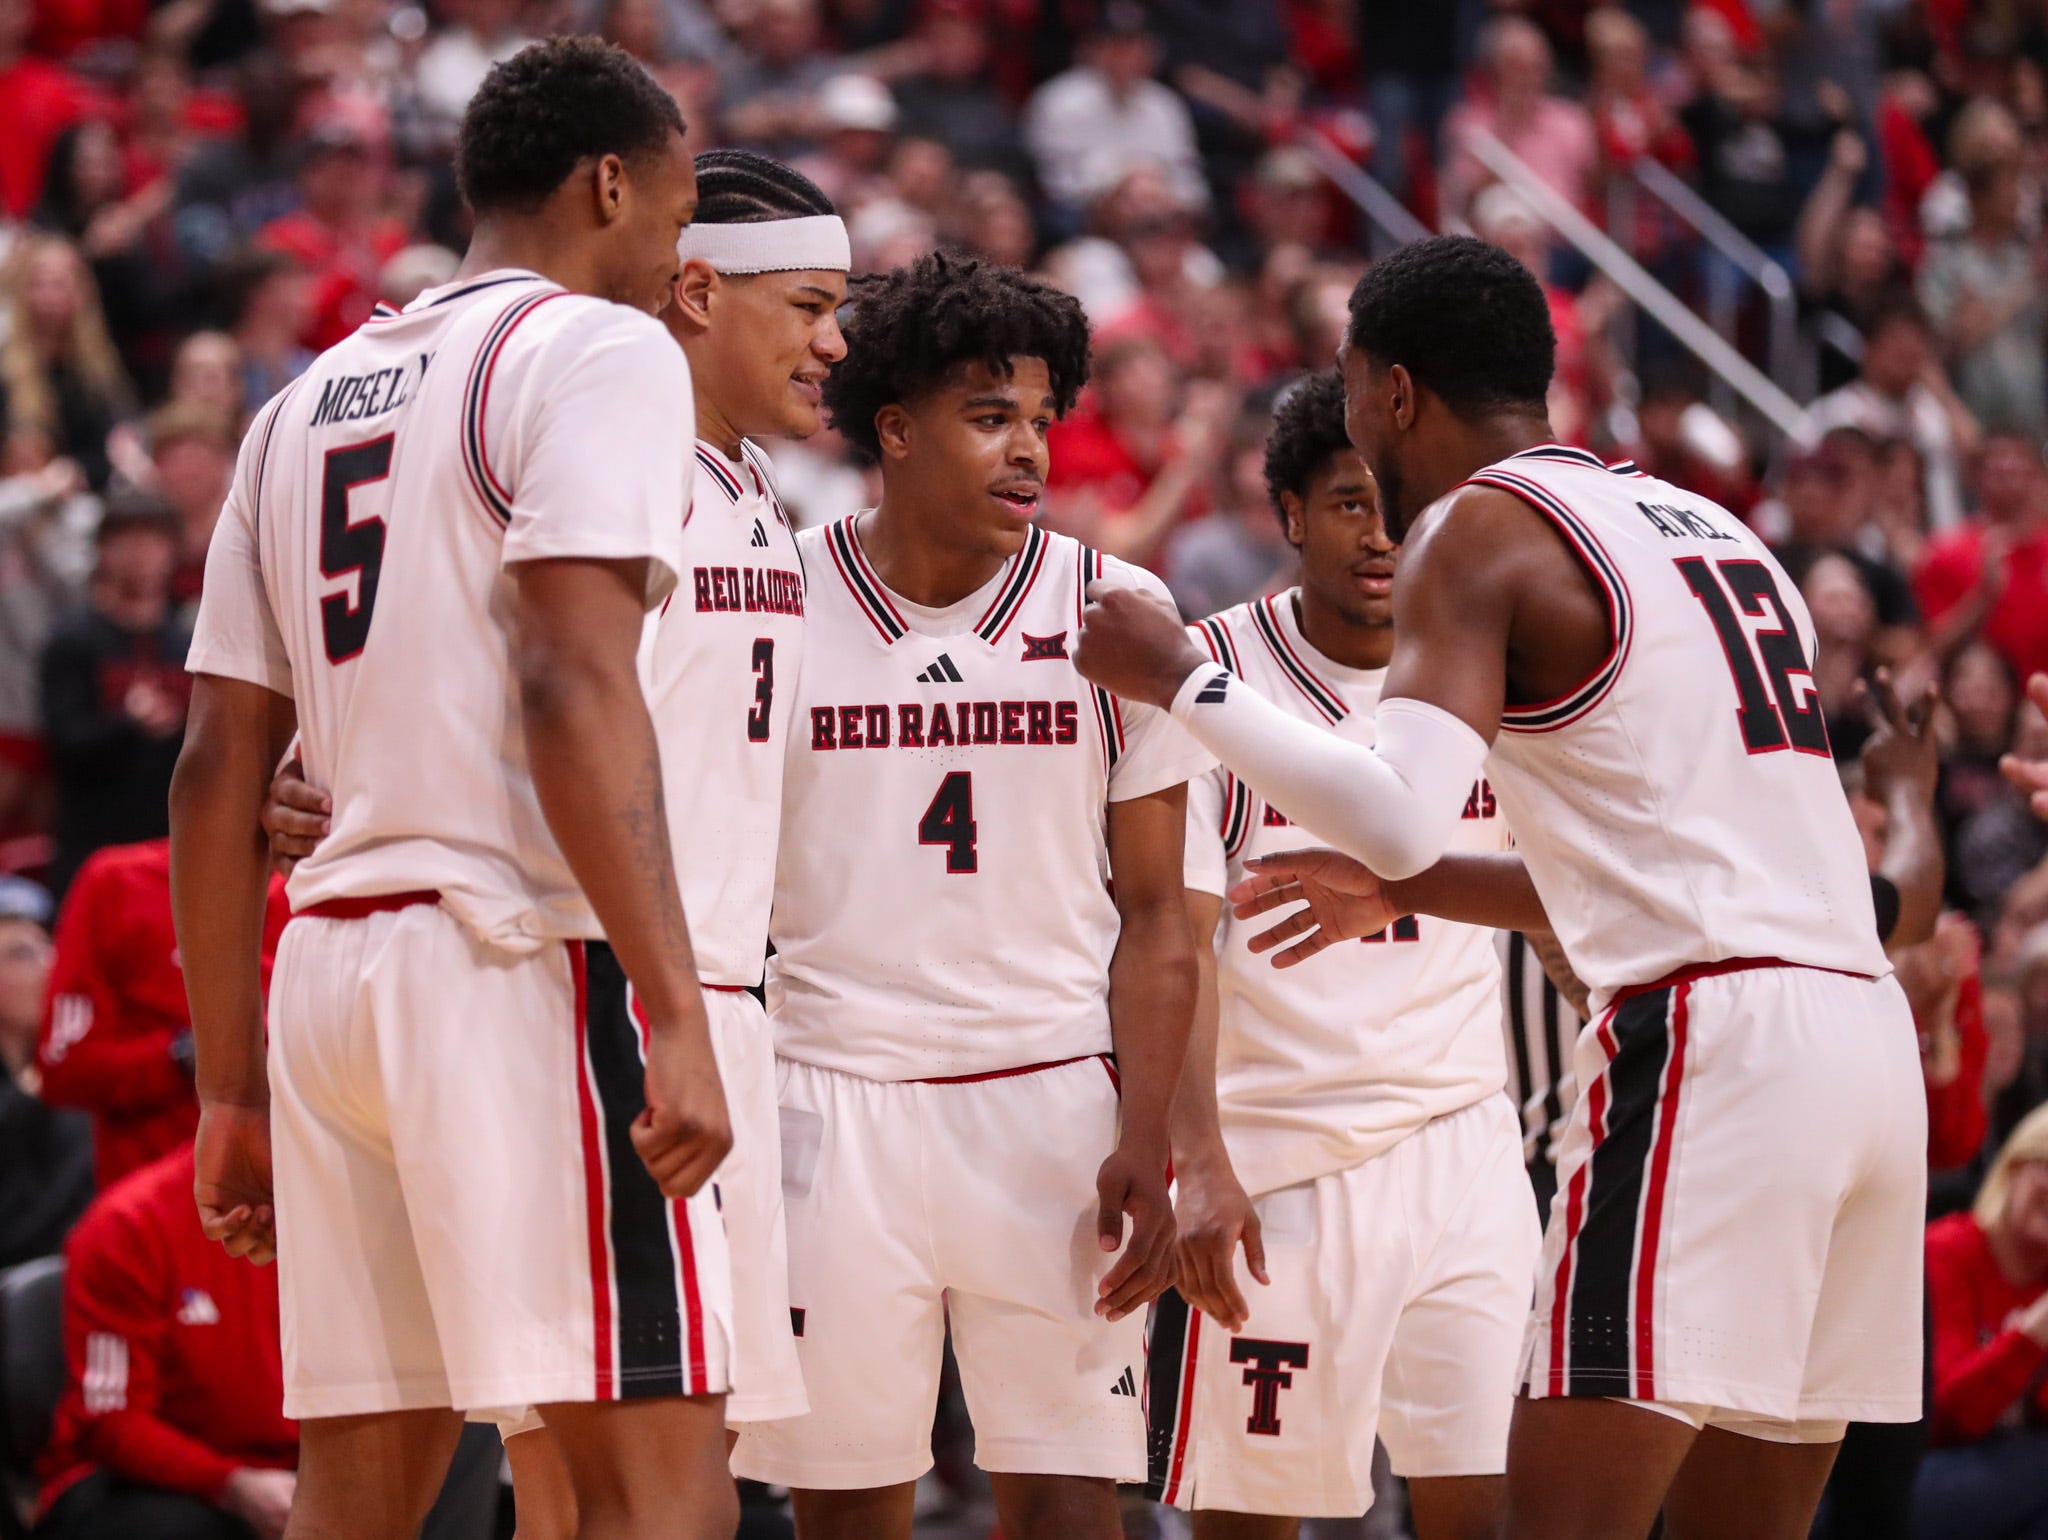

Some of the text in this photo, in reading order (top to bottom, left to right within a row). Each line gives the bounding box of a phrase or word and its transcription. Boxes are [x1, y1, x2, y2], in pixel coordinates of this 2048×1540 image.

[319, 431, 395, 667] 5
[693, 566, 741, 613] RED
[748, 637, 774, 742] 3
[1672, 555, 1832, 759] 12
[811, 701, 1077, 750] RED RAIDERS
[919, 771, 977, 874] 4
